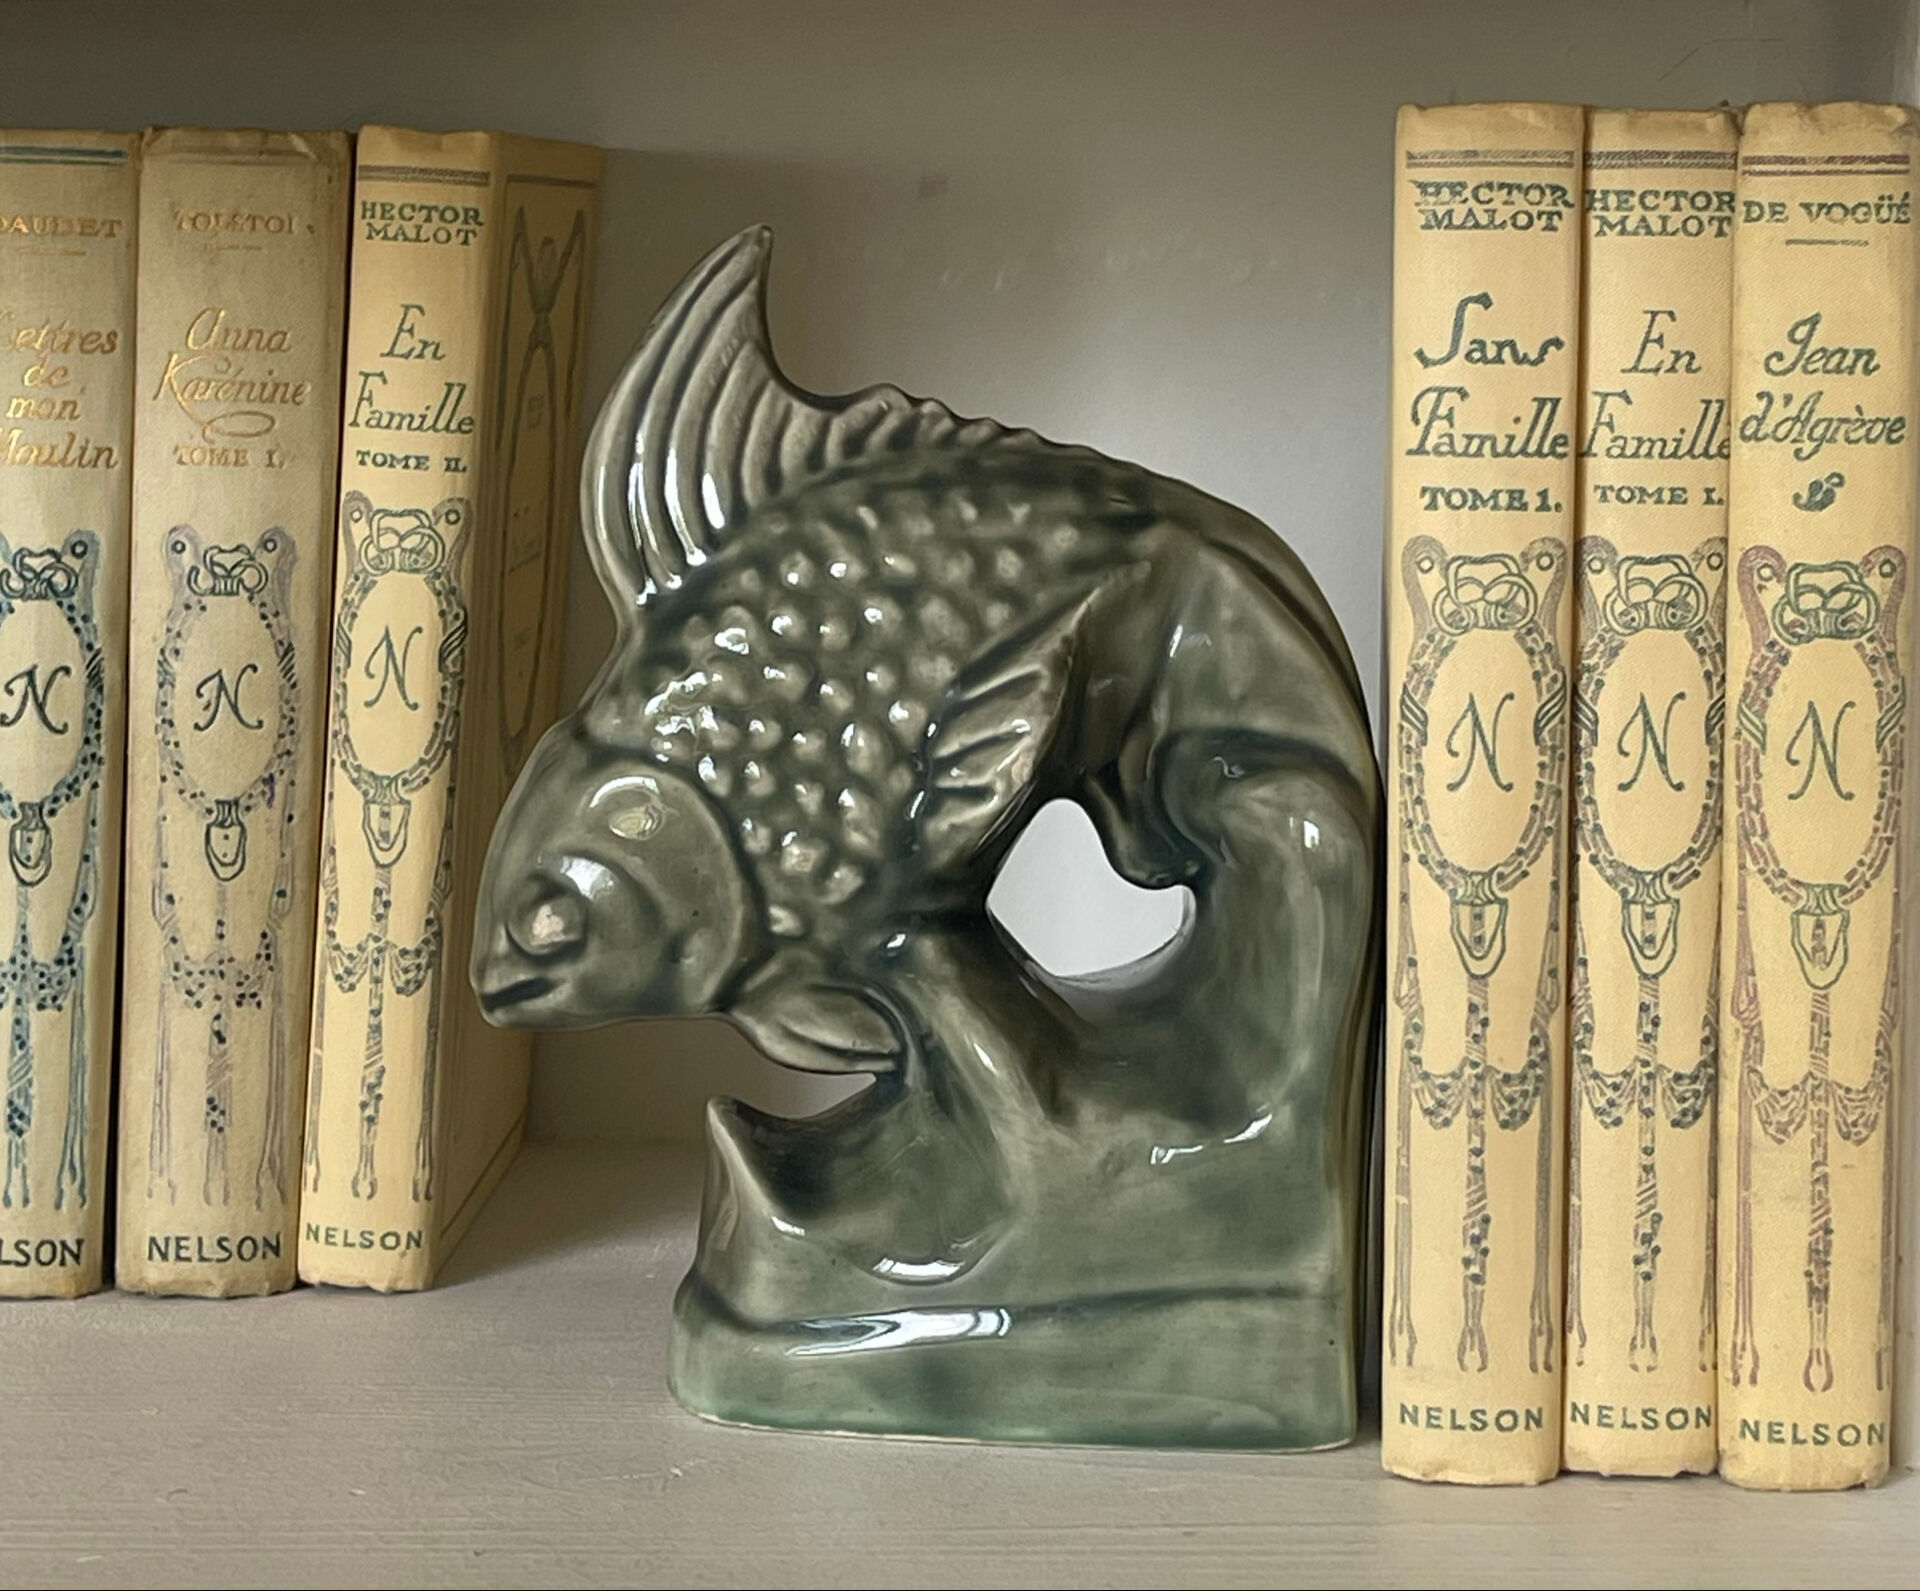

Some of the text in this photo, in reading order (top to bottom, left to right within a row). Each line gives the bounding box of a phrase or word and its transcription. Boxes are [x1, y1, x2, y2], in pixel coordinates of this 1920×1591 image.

[1408, 179, 1575, 209] HECTOR
[1584, 188, 1736, 214] HECTOR
[361, 201, 485, 226] HECTOR
[1419, 207, 1563, 232] MALOT
[1593, 214, 1733, 239] MALOT
[1742, 200, 1790, 224] DE
[365, 222, 478, 246] MALOT
[185, 306, 292, 353] Anna
[379, 303, 446, 361] En
[1413, 291, 1565, 370] Sans
[1620, 309, 1702, 375] En
[1763, 311, 1882, 377] Jean
[23, 352, 71, 388] de
[5, 396, 80, 421] mon
[348, 371, 476, 436] Famille
[1405, 385, 1570, 460] Famille
[1576, 388, 1731, 460] Famille
[173, 445, 249, 468] TOME
[356, 449, 430, 472] TOME
[1419, 485, 1530, 512] TOME
[1593, 484, 1689, 505] TOME
[363, 626, 424, 711] N
[0, 664, 71, 734] N
[193, 664, 264, 731] N
[1445, 692, 1516, 793] N
[1616, 691, 1687, 792] N
[1785, 699, 1857, 801] N
[147, 1232, 282, 1264] NELSON
[306, 1222, 424, 1251] NELSON
[1398, 1401, 1546, 1432] NELSON
[1569, 1401, 1713, 1430] NELSON
[1738, 1417, 1886, 1447] NELSON
